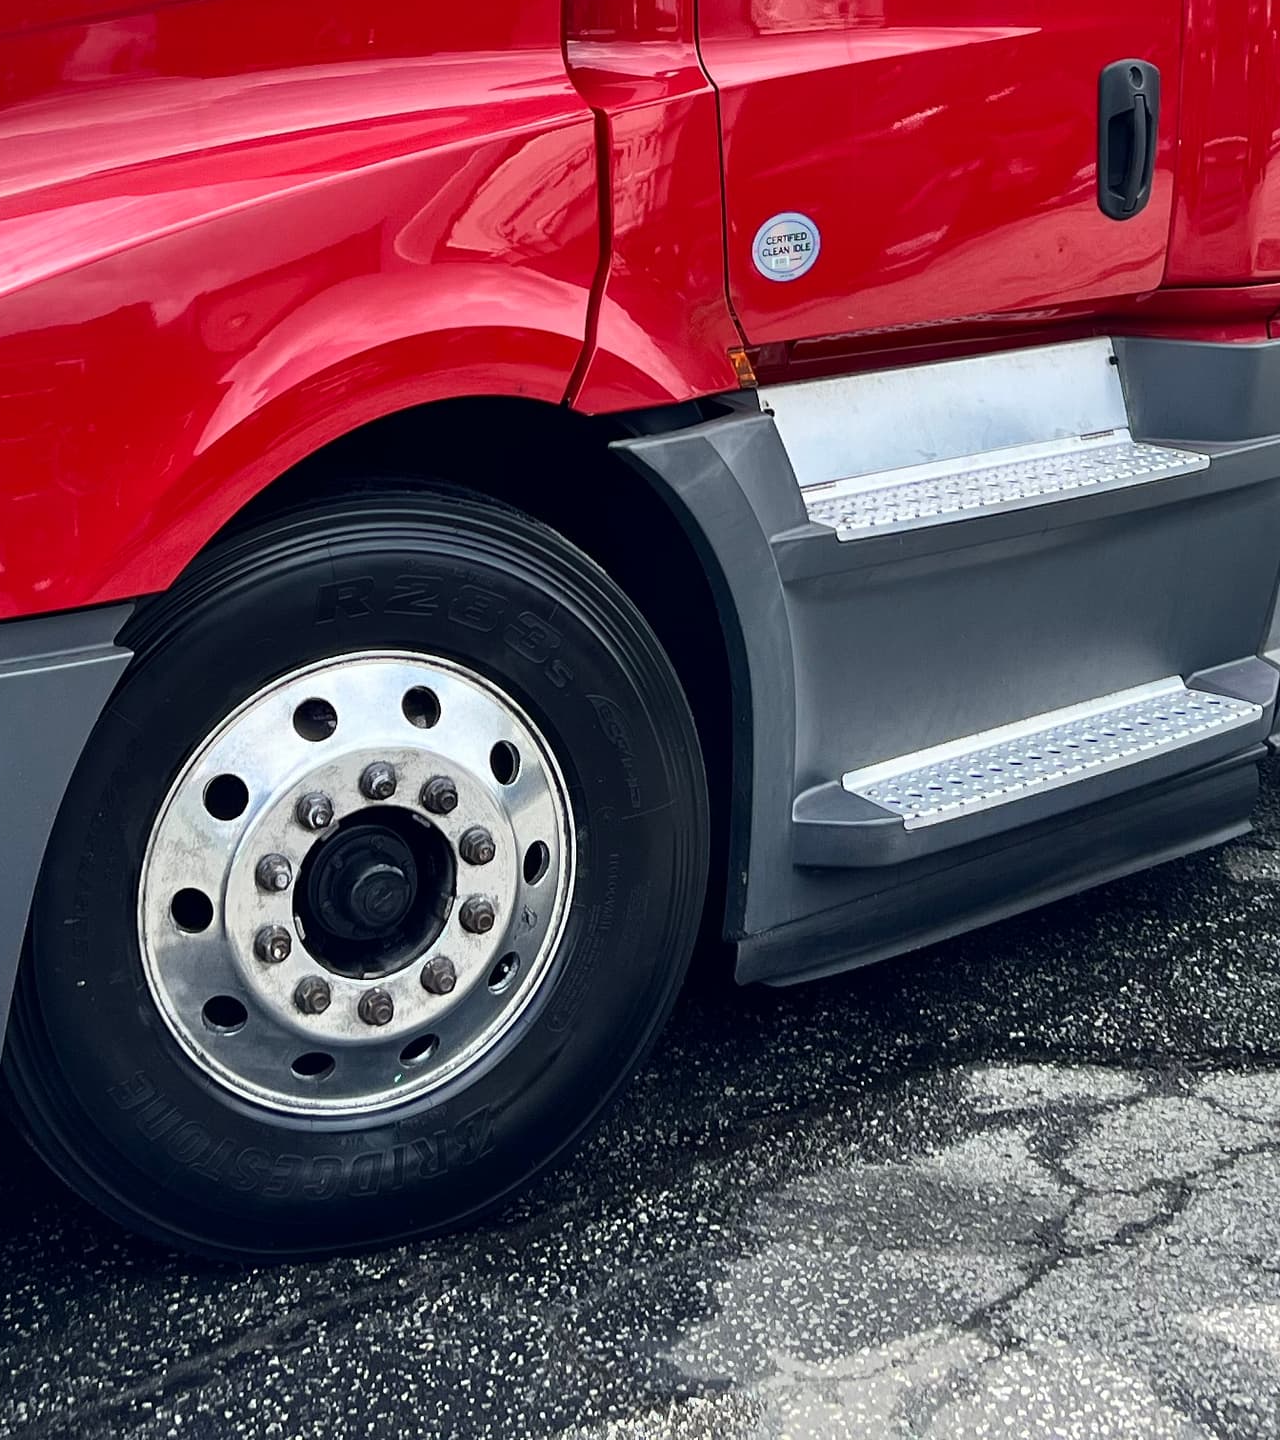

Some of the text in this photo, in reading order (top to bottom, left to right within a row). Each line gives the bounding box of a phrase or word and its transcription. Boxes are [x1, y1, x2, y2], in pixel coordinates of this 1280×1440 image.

[766, 231, 808, 246] CERTIFIED
[762, 242, 811, 257] CLEAN IDLE
[104, 1069, 497, 1200] BRIDGESTONE
